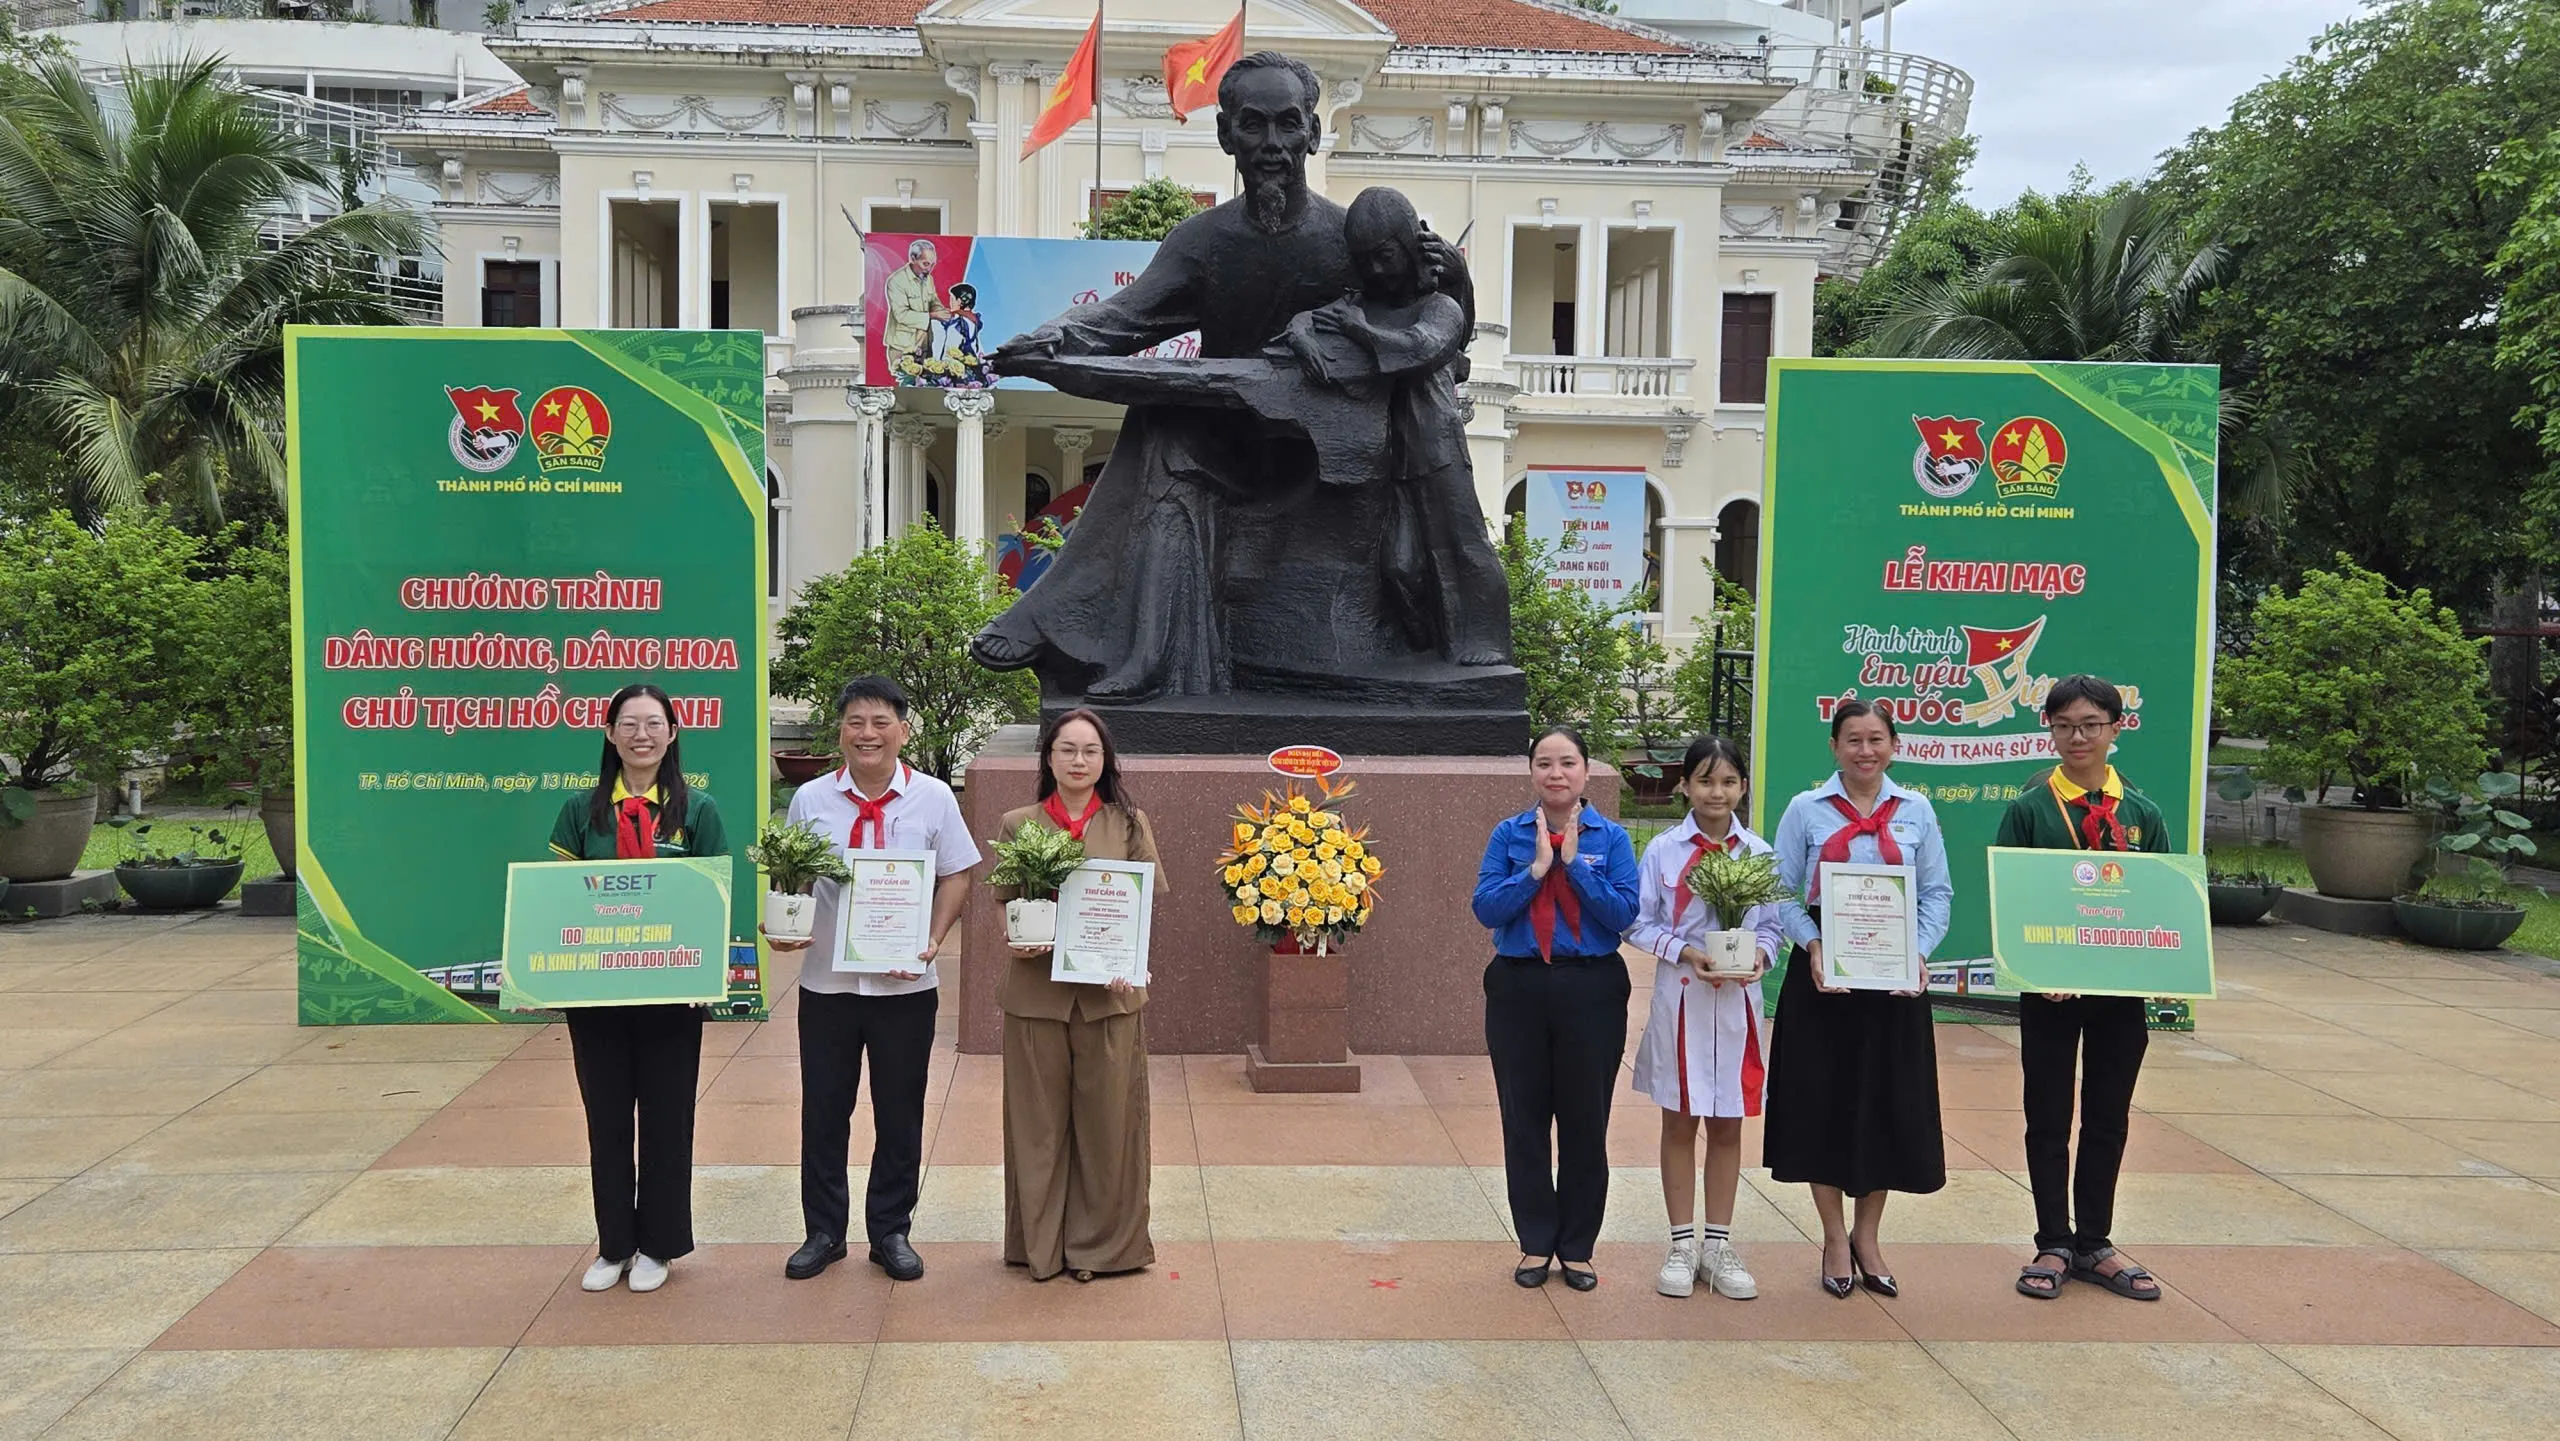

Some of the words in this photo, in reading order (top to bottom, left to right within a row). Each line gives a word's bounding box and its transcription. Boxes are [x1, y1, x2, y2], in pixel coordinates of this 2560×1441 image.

[436, 476, 490, 493] THÀNH
[494, 475, 526, 493] PHỐ
[529, 475, 551, 493] HỒ
[554, 477, 580, 493] CHÍ
[583, 481, 622, 494] MINH
[1899, 501, 1950, 517] THÀNH
[1953, 501, 1984, 518] PHỐ
[1986, 501, 2008, 518] HỒ
[2010, 504, 2035, 519] CHÍ
[2037, 507, 2075, 519] MINH
[1612, 579, 1622, 589] TA
[1884, 545, 1926, 590] LỄ
[1927, 562, 2008, 593] KHAI
[2011, 563, 2086, 600] MẠC
[401, 572, 549, 611] CHƯƠNG
[552, 570, 662, 611] TRÌNH
[324, 628, 424, 669] DÂNG
[428, 632, 559, 673] HƯƠNG,
[563, 629, 660, 670] DÂNG
[665, 638, 739, 670] HOA
[1843, 624, 1906, 655] Hành
[1906, 625, 1963, 653] trình
[1859, 654, 1910, 686] Em
[1913, 655, 1971, 696] yêu
[343, 686, 419, 729] CHỦ
[422, 697, 503, 735] TỊCH
[507, 683, 560, 729] HỒ
[563, 689, 622, 729] CH
[671, 697, 722, 729] NH
[1907, 740, 1946, 761] NGỜI
[1952, 740, 2007, 760] TRANG
[358, 772, 380, 790] TP.
[384, 770, 410, 790] Hồ
[413, 771, 443, 790] Chí
[444, 773, 489, 791] Minh,
[492, 773, 537, 792] ngày
[541, 773, 560, 790] 13
[562, 770, 600, 790] thán
[1936, 784, 1977, 802] ngày
[1981, 783, 2001, 801] 13
[583, 874, 658, 891] WESET
[560, 927, 583, 946] 100
[584, 926, 614, 945] BALO
[615, 925, 641, 946] HỌC
[642, 924, 672, 944] SINH
[2024, 925, 2054, 944] KINH
[2056, 924, 2077, 945] PHÍ
[2078, 926, 2145, 947] 15.000.000
[2146, 925, 2181, 949] ĐỒNG
[529, 951, 546, 973] VÀ
[548, 951, 577, 972] KINH
[578, 949, 600, 971] PHÍ
[601, 950, 666, 970] 10.000.000
[668, 944, 702, 969] ĐỒNG
